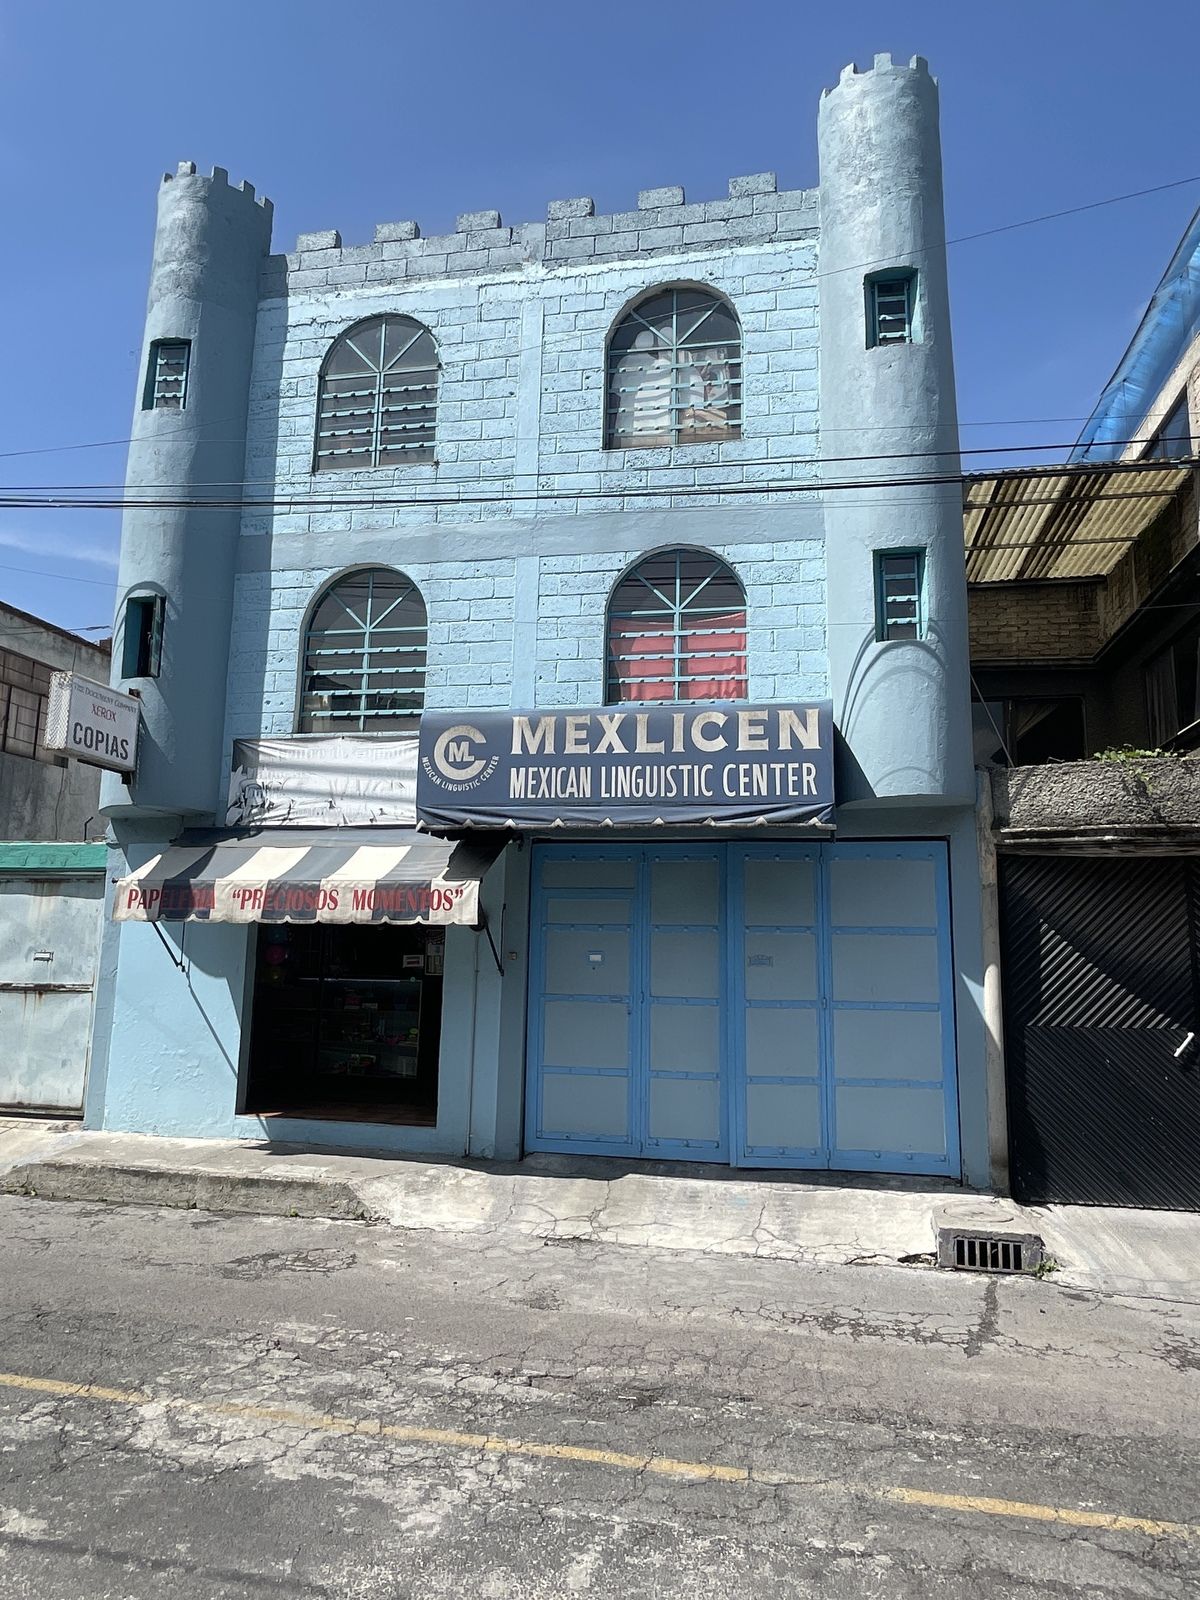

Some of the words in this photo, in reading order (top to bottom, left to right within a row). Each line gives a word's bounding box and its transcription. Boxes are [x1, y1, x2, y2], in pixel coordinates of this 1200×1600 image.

[91, 703, 117, 722] XEROX
[510, 708, 822, 754] MEXLICEN
[73, 722, 129, 760] COPIAS
[421, 756, 442, 785] MEXICAN
[441, 779, 481, 792] LINGUISTIC
[480, 755, 500, 781] CENTER
[509, 766, 592, 799] MEXICAN
[600, 763, 715, 798] LINGUISTIC
[722, 762, 818, 797] CENTER
